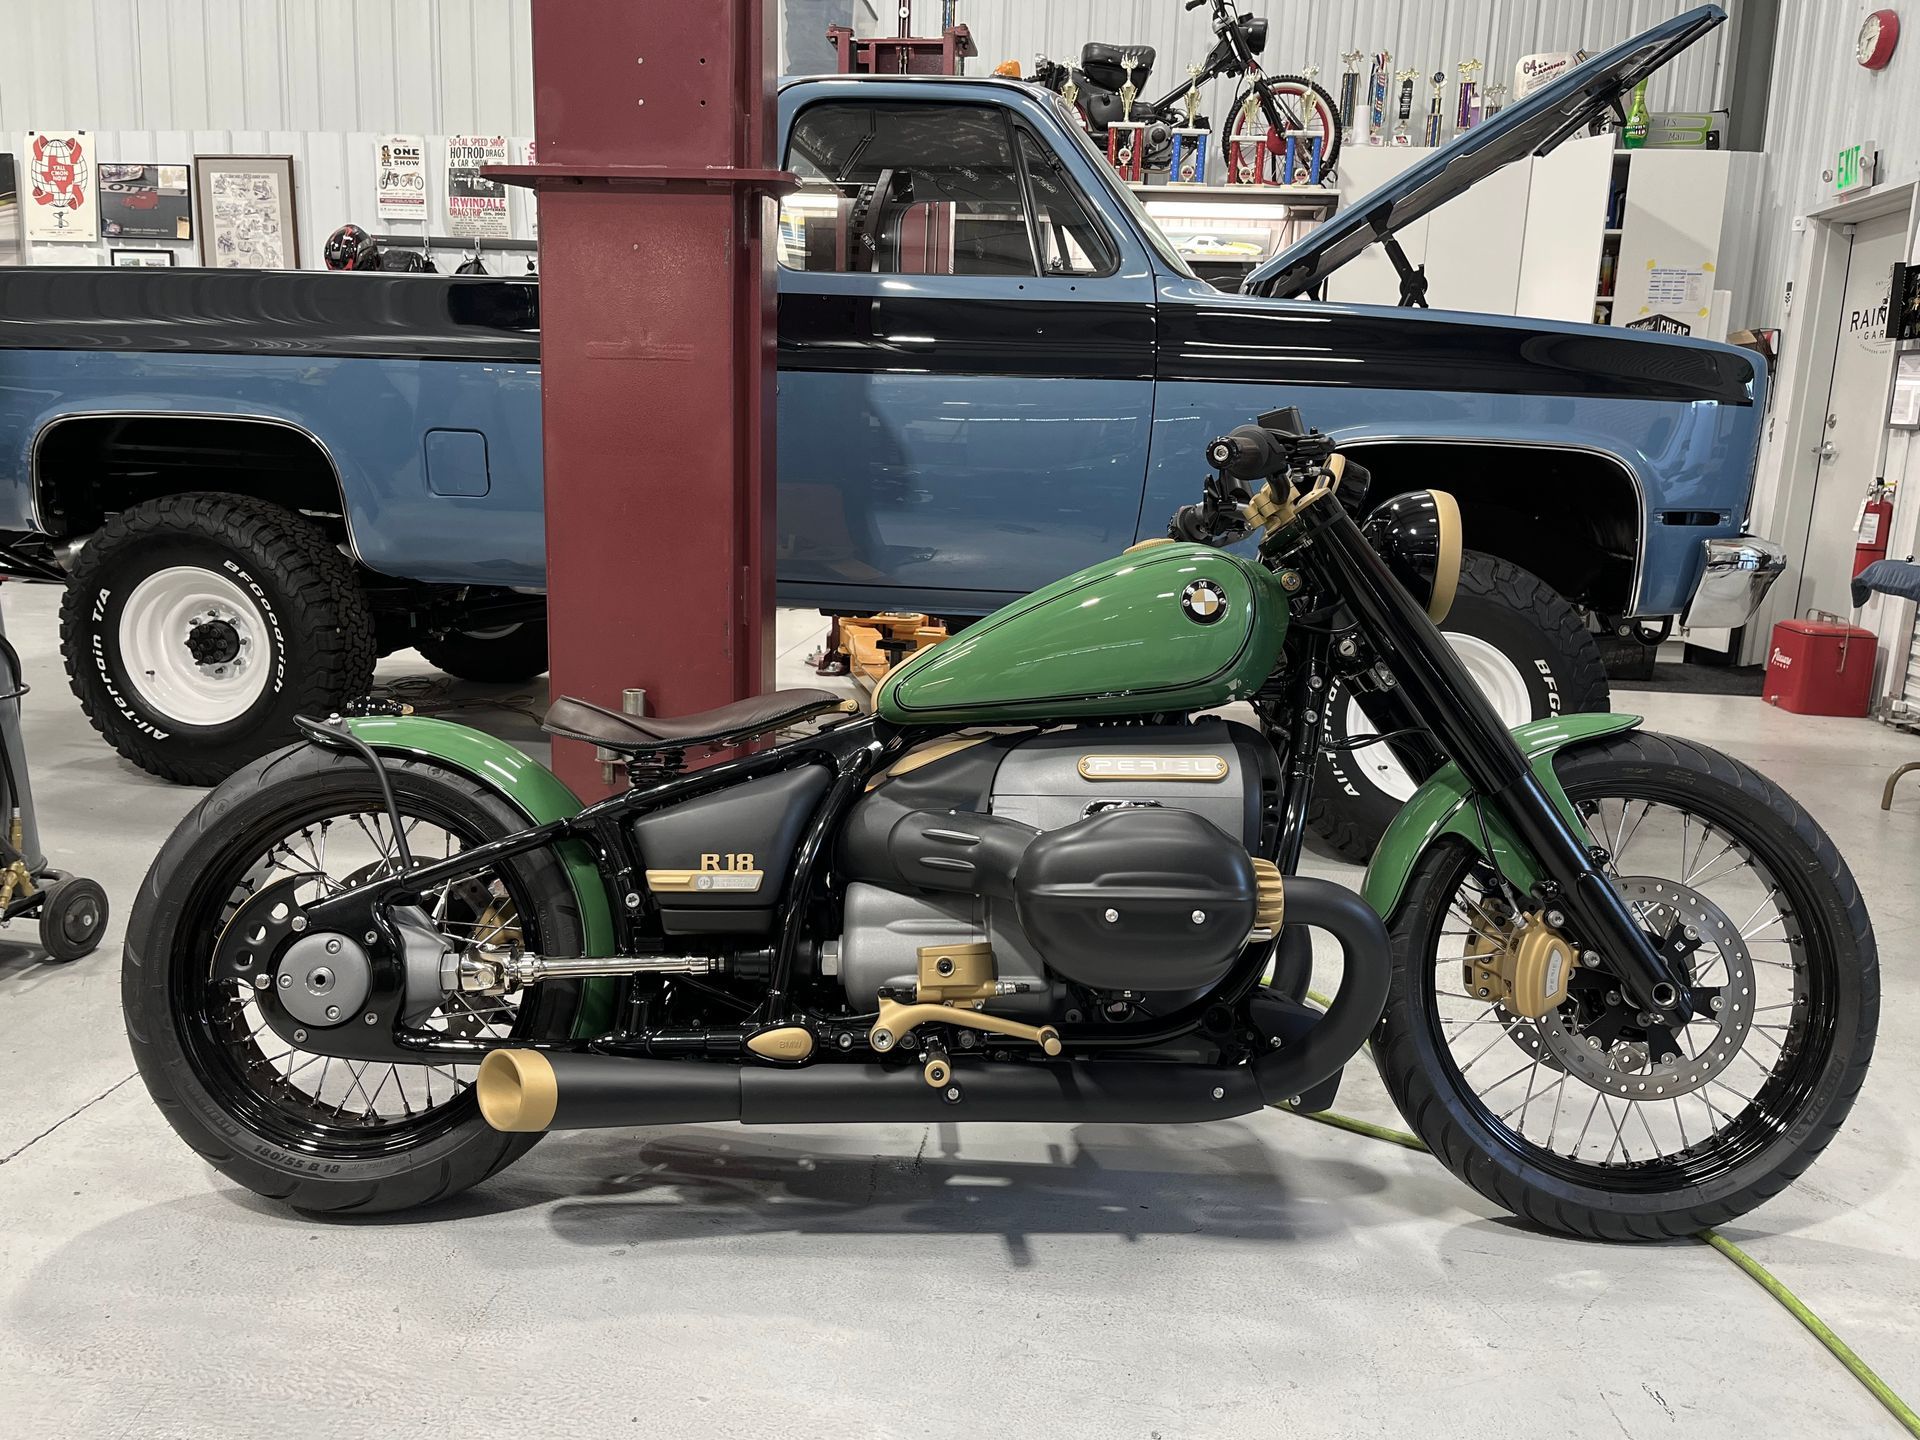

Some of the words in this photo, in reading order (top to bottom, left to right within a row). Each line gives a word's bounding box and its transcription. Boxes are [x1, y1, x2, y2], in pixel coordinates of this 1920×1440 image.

[1523, 60, 1537, 74] 64
[1532, 60, 1566, 77] CAMINO
[449, 138, 468, 146] SO-CAL
[471, 138, 488, 147] SPEED
[490, 138, 505, 147] SHOP
[393, 148, 420, 156] ONE
[450, 147, 485, 159] HOTROD
[486, 149, 505, 158] DRAGS
[458, 159, 469, 167] CAR
[472, 159, 488, 167] SHOW
[1837, 145, 1860, 189] EXIT
[450, 197, 505, 209] IRWINDALE
[449, 207, 482, 217] DRAGSTRIP
[1660, 320, 1689, 336] CHEAP
[1186, 581, 1222, 595] BMW
[92, 588, 111, 623] T/A
[223, 559, 288, 693] BFGoodrich
[92, 634, 169, 742] All-Terrain
[701, 853, 721, 872] R
[725, 853, 754, 872] 18
[254, 1144, 305, 1169] 180/55
[308, 1162, 320, 1172] B
[323, 1164, 341, 1174] 18
